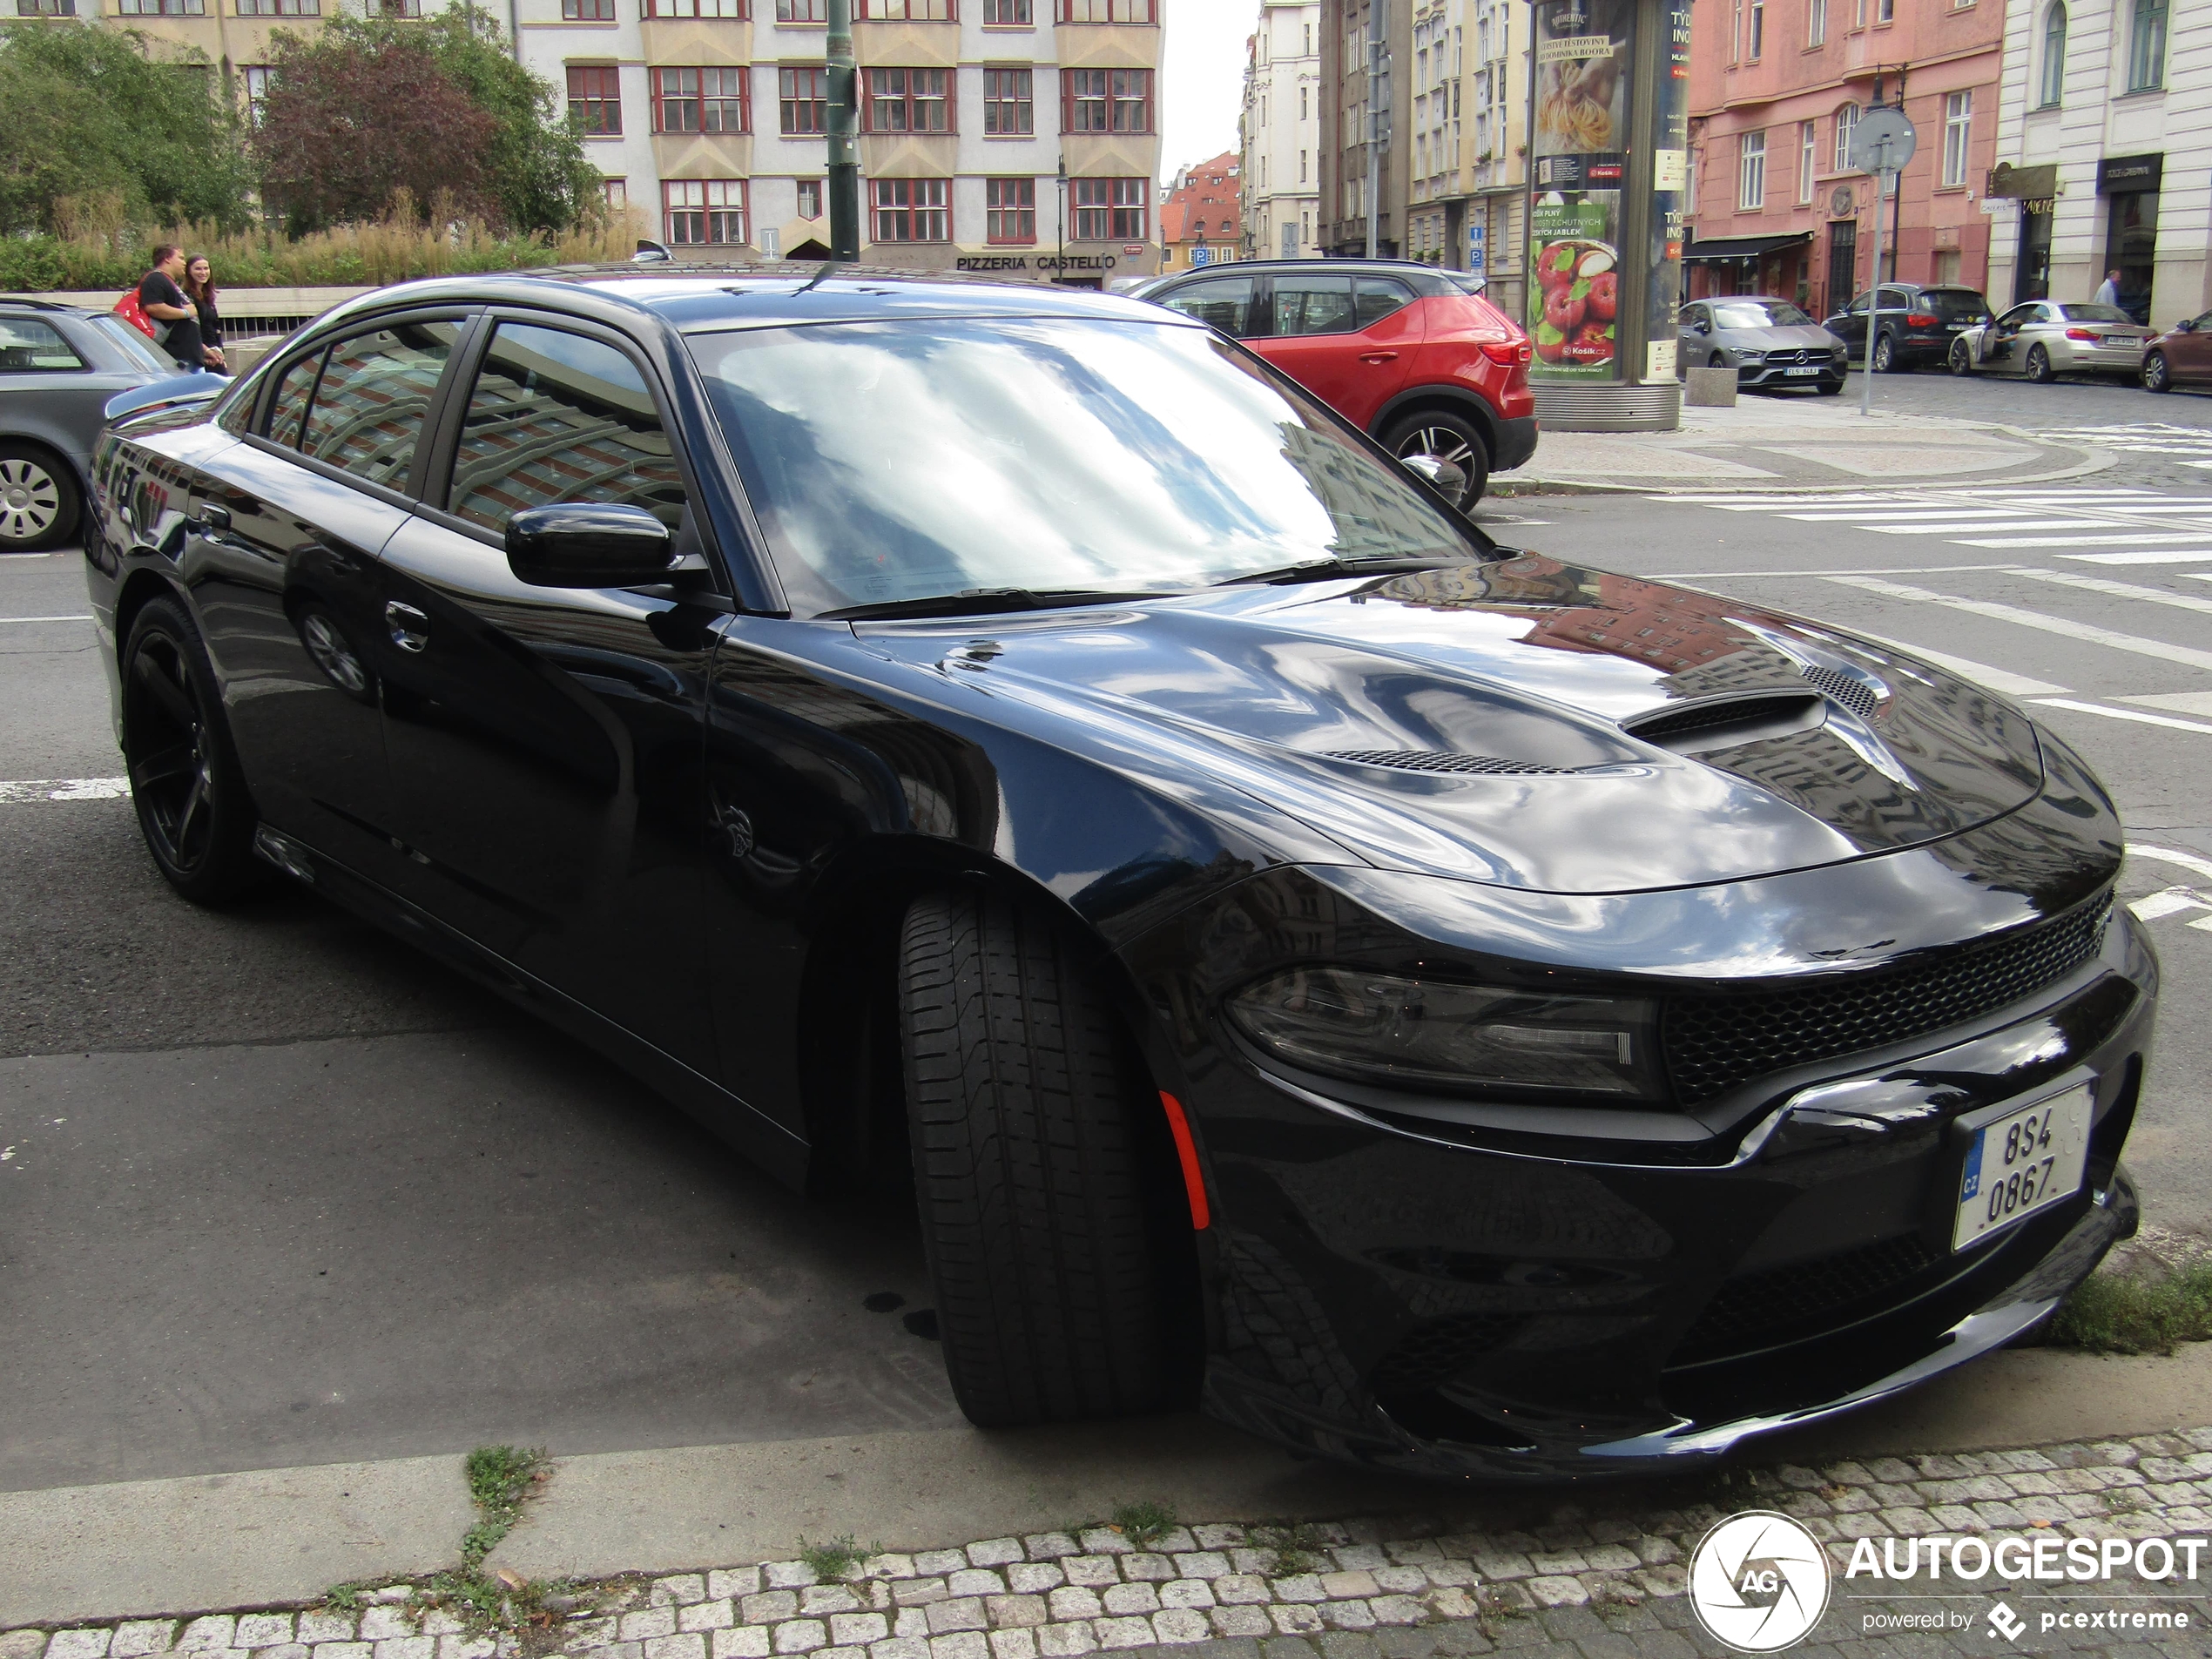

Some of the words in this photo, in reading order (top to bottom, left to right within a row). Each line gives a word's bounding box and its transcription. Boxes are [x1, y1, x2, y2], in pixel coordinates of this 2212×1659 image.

[1551, 13, 1587, 27] AUTHENTIC
[1564, 37, 1605, 48] TĚSTOVINY
[1546, 50, 1578, 59] DOMINIKA
[1580, 47, 1610, 56] BOORA
[1544, 208, 1561, 217] PLNÝ
[1556, 218, 1601, 226] CHUTNÝCH
[957, 257, 1026, 270] PIZZERIA
[1037, 255, 1116, 270] CASTELLO
[1572, 347, 1606, 355] Košík.cz
[2004, 1105, 2053, 1165] 8S4
[1964, 1175, 1977, 1194] CZ
[1987, 1153, 2055, 1222] 0867
